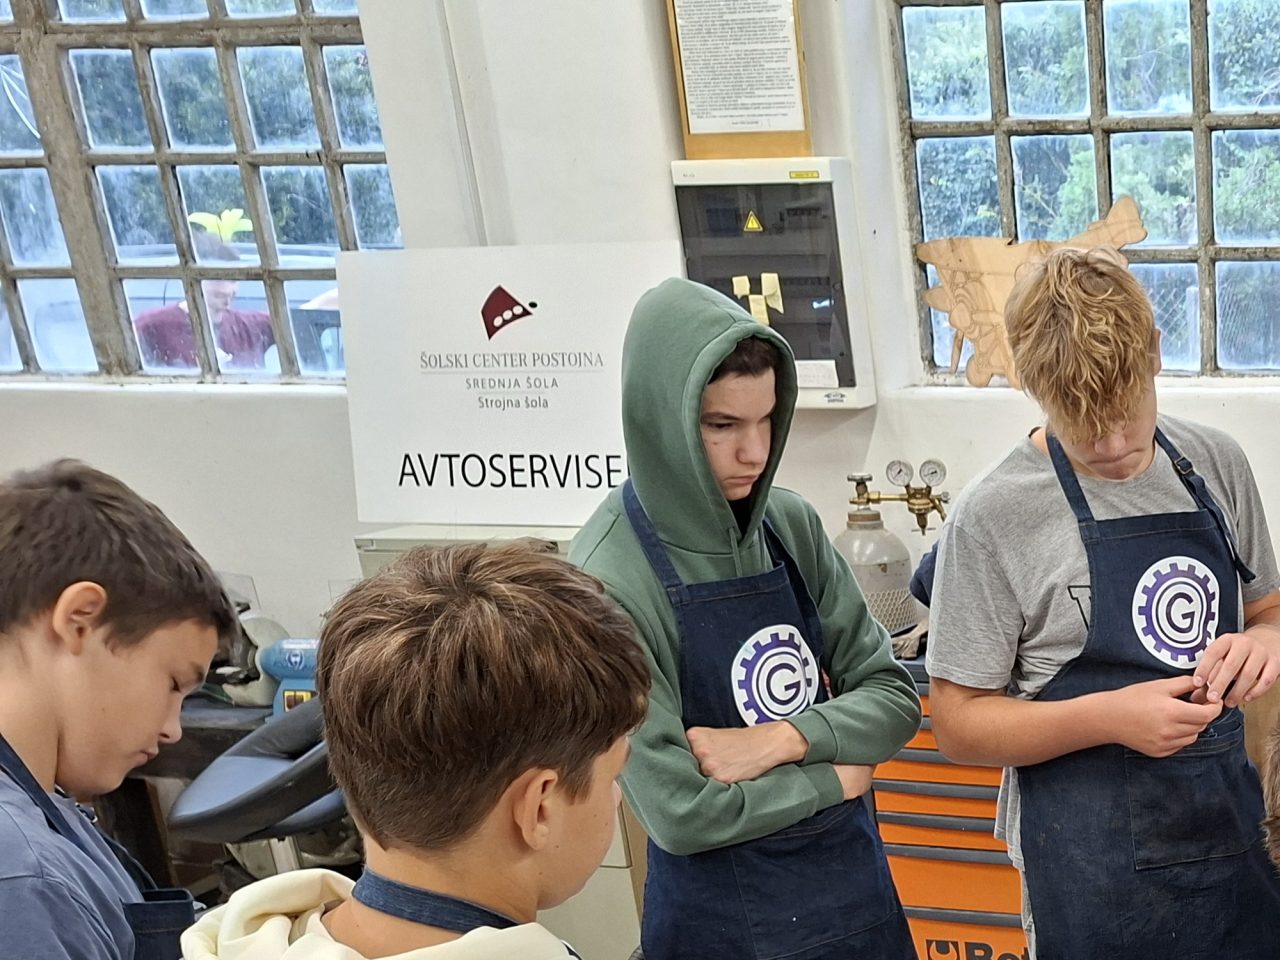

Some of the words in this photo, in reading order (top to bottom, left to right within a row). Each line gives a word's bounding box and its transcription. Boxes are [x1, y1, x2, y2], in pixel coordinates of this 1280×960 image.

[420, 351, 469, 369] ŠOLSKI
[472, 353, 528, 368] CENTER
[532, 352, 604, 368] POSTOJNA
[465, 377, 521, 389] SREDNJA
[526, 376, 559, 389] ŠOLA
[478, 396, 521, 411] Strojna
[525, 395, 549, 409] šola
[399, 453, 630, 489] AVTOSERVISE
